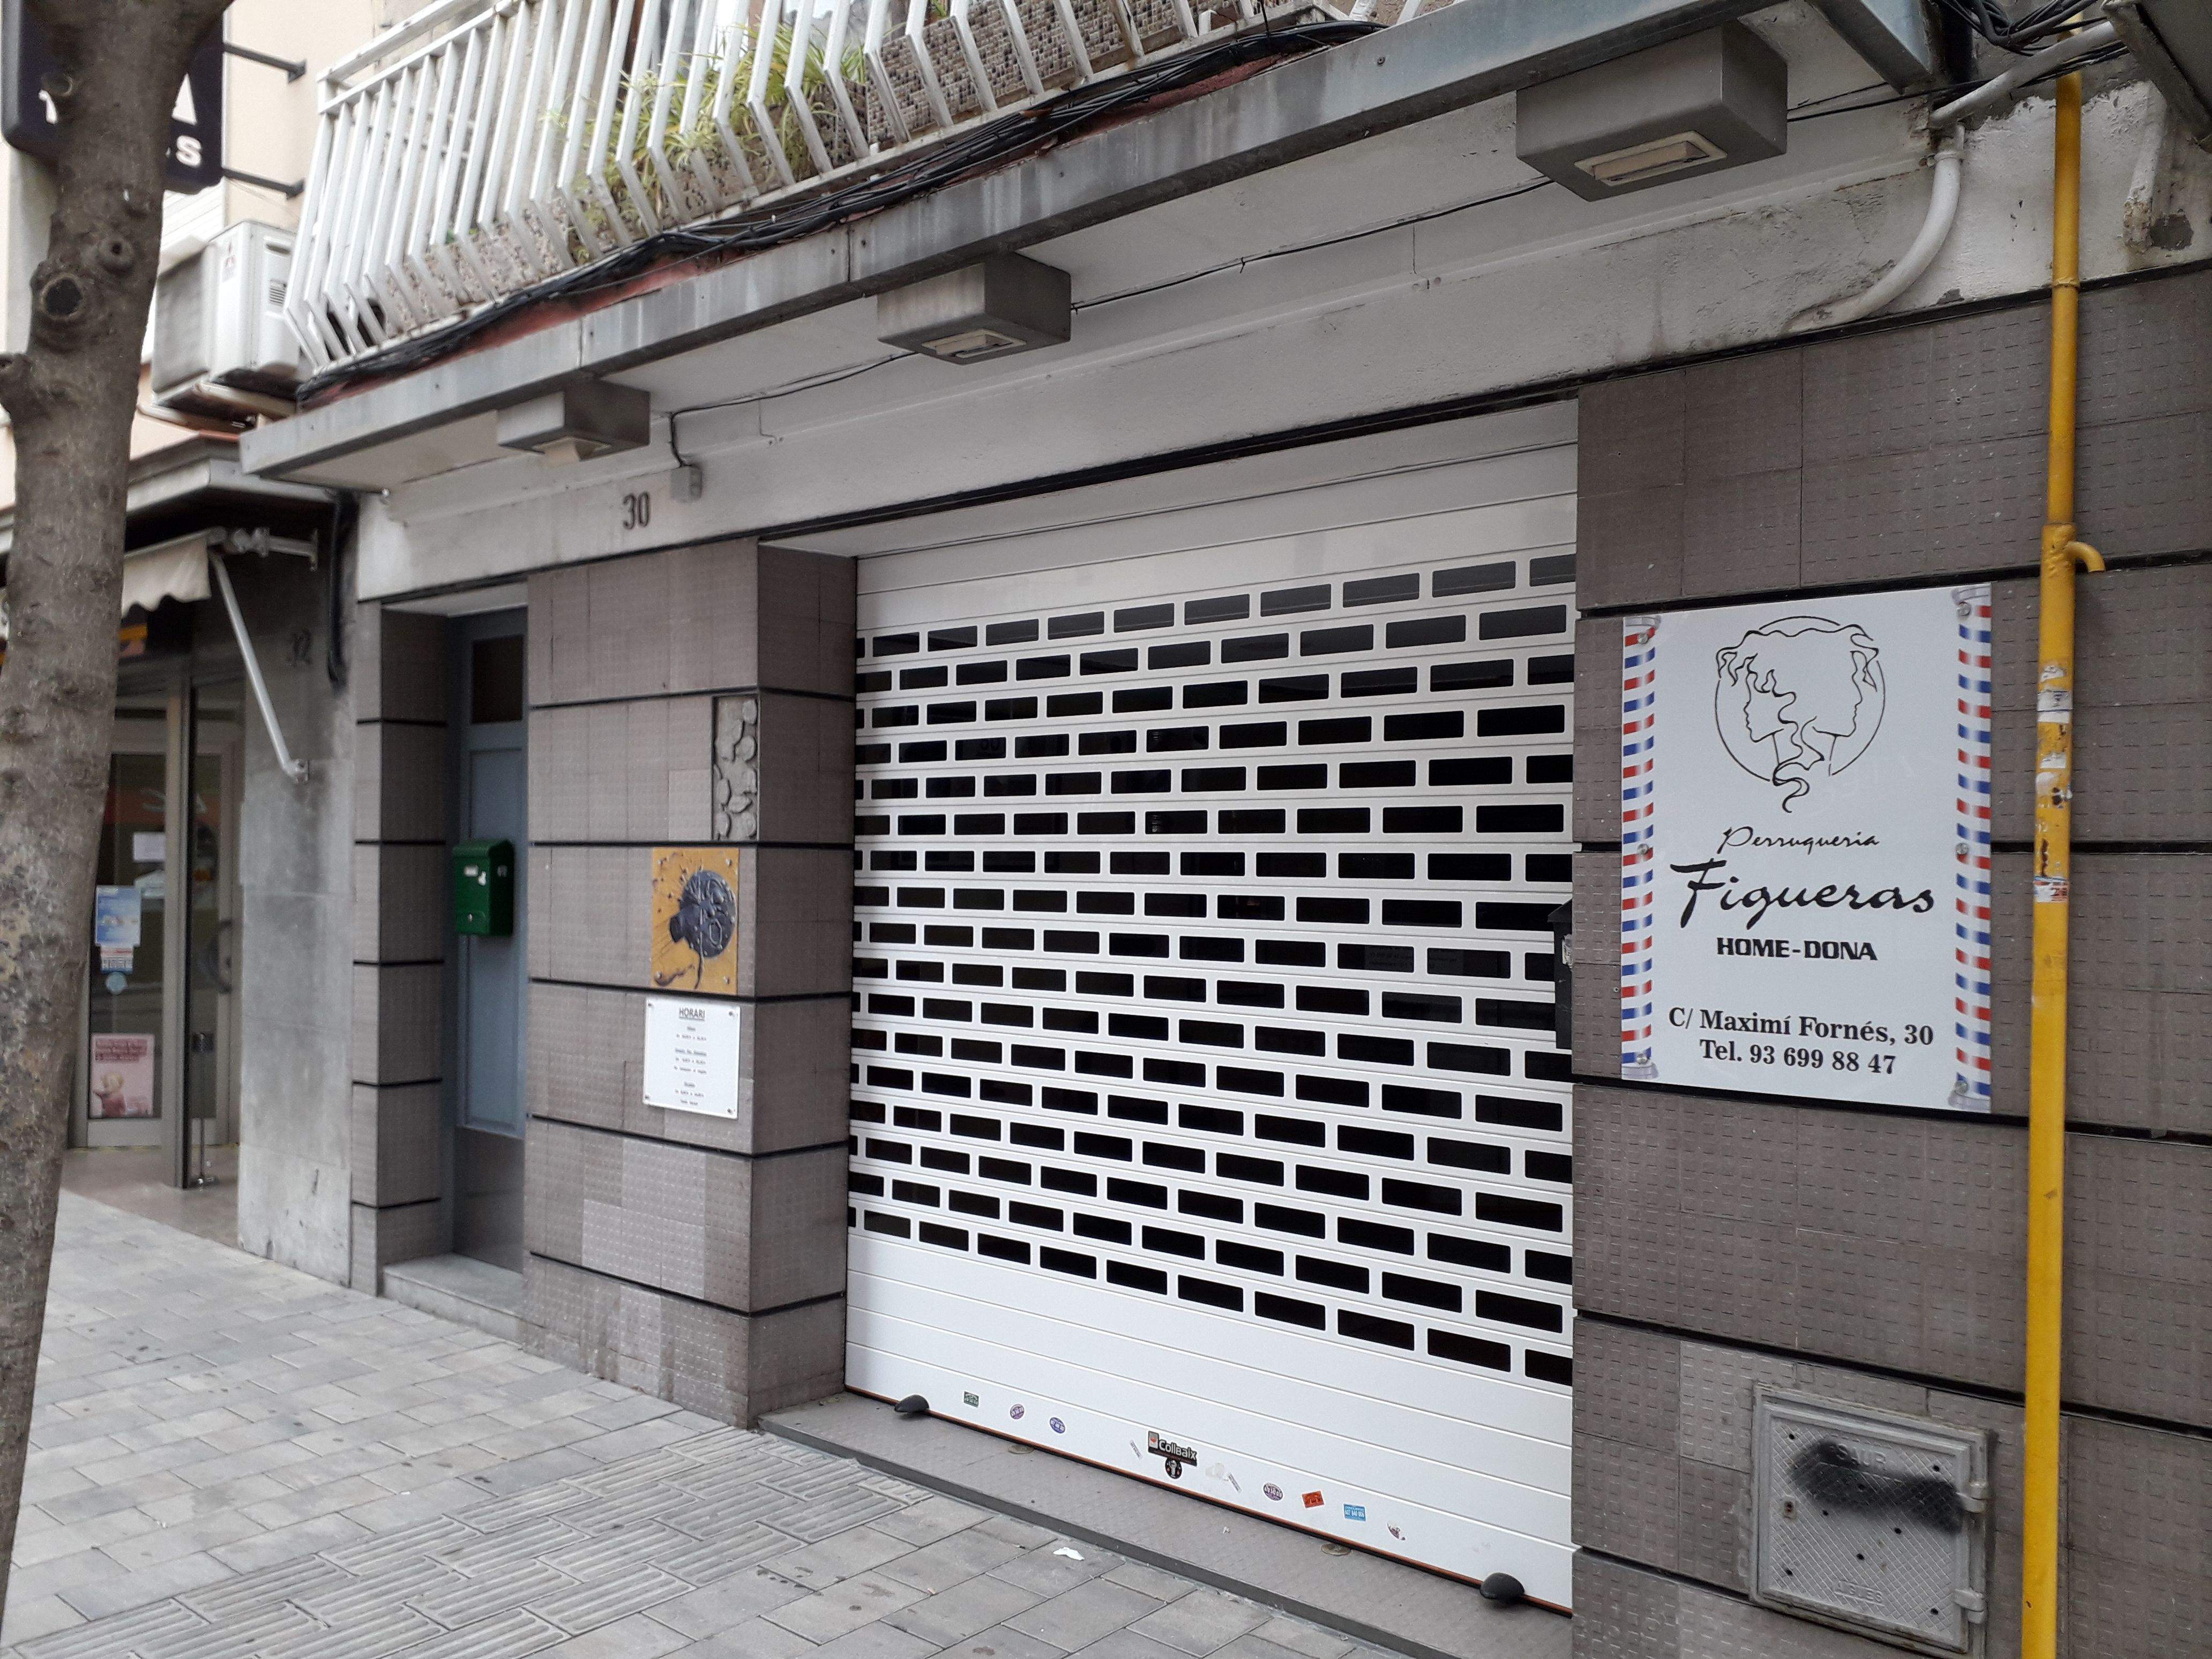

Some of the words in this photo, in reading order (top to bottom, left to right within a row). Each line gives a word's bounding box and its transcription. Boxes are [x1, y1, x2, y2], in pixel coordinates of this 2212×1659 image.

[623, 492, 649, 529] 30
[1716, 826, 1880, 855] Perruqueria
[1670, 857, 1934, 930] Figueras
[1716, 937, 1878, 961] HOME-DONA
[679, 1007, 705, 1019] HORARI
[1669, 1007, 1694, 1029] C/
[1699, 1009, 1791, 1035] Maximí
[1798, 1016, 1895, 1046] Fornés,
[1904, 1024, 1933, 1045] 30
[1699, 1039, 1742, 1062] Tel.
[1750, 1044, 1775, 1065] 93
[1783, 1047, 1824, 1068] 699
[1832, 1051, 1859, 1072] 88
[1868, 1053, 1896, 1074] 47
